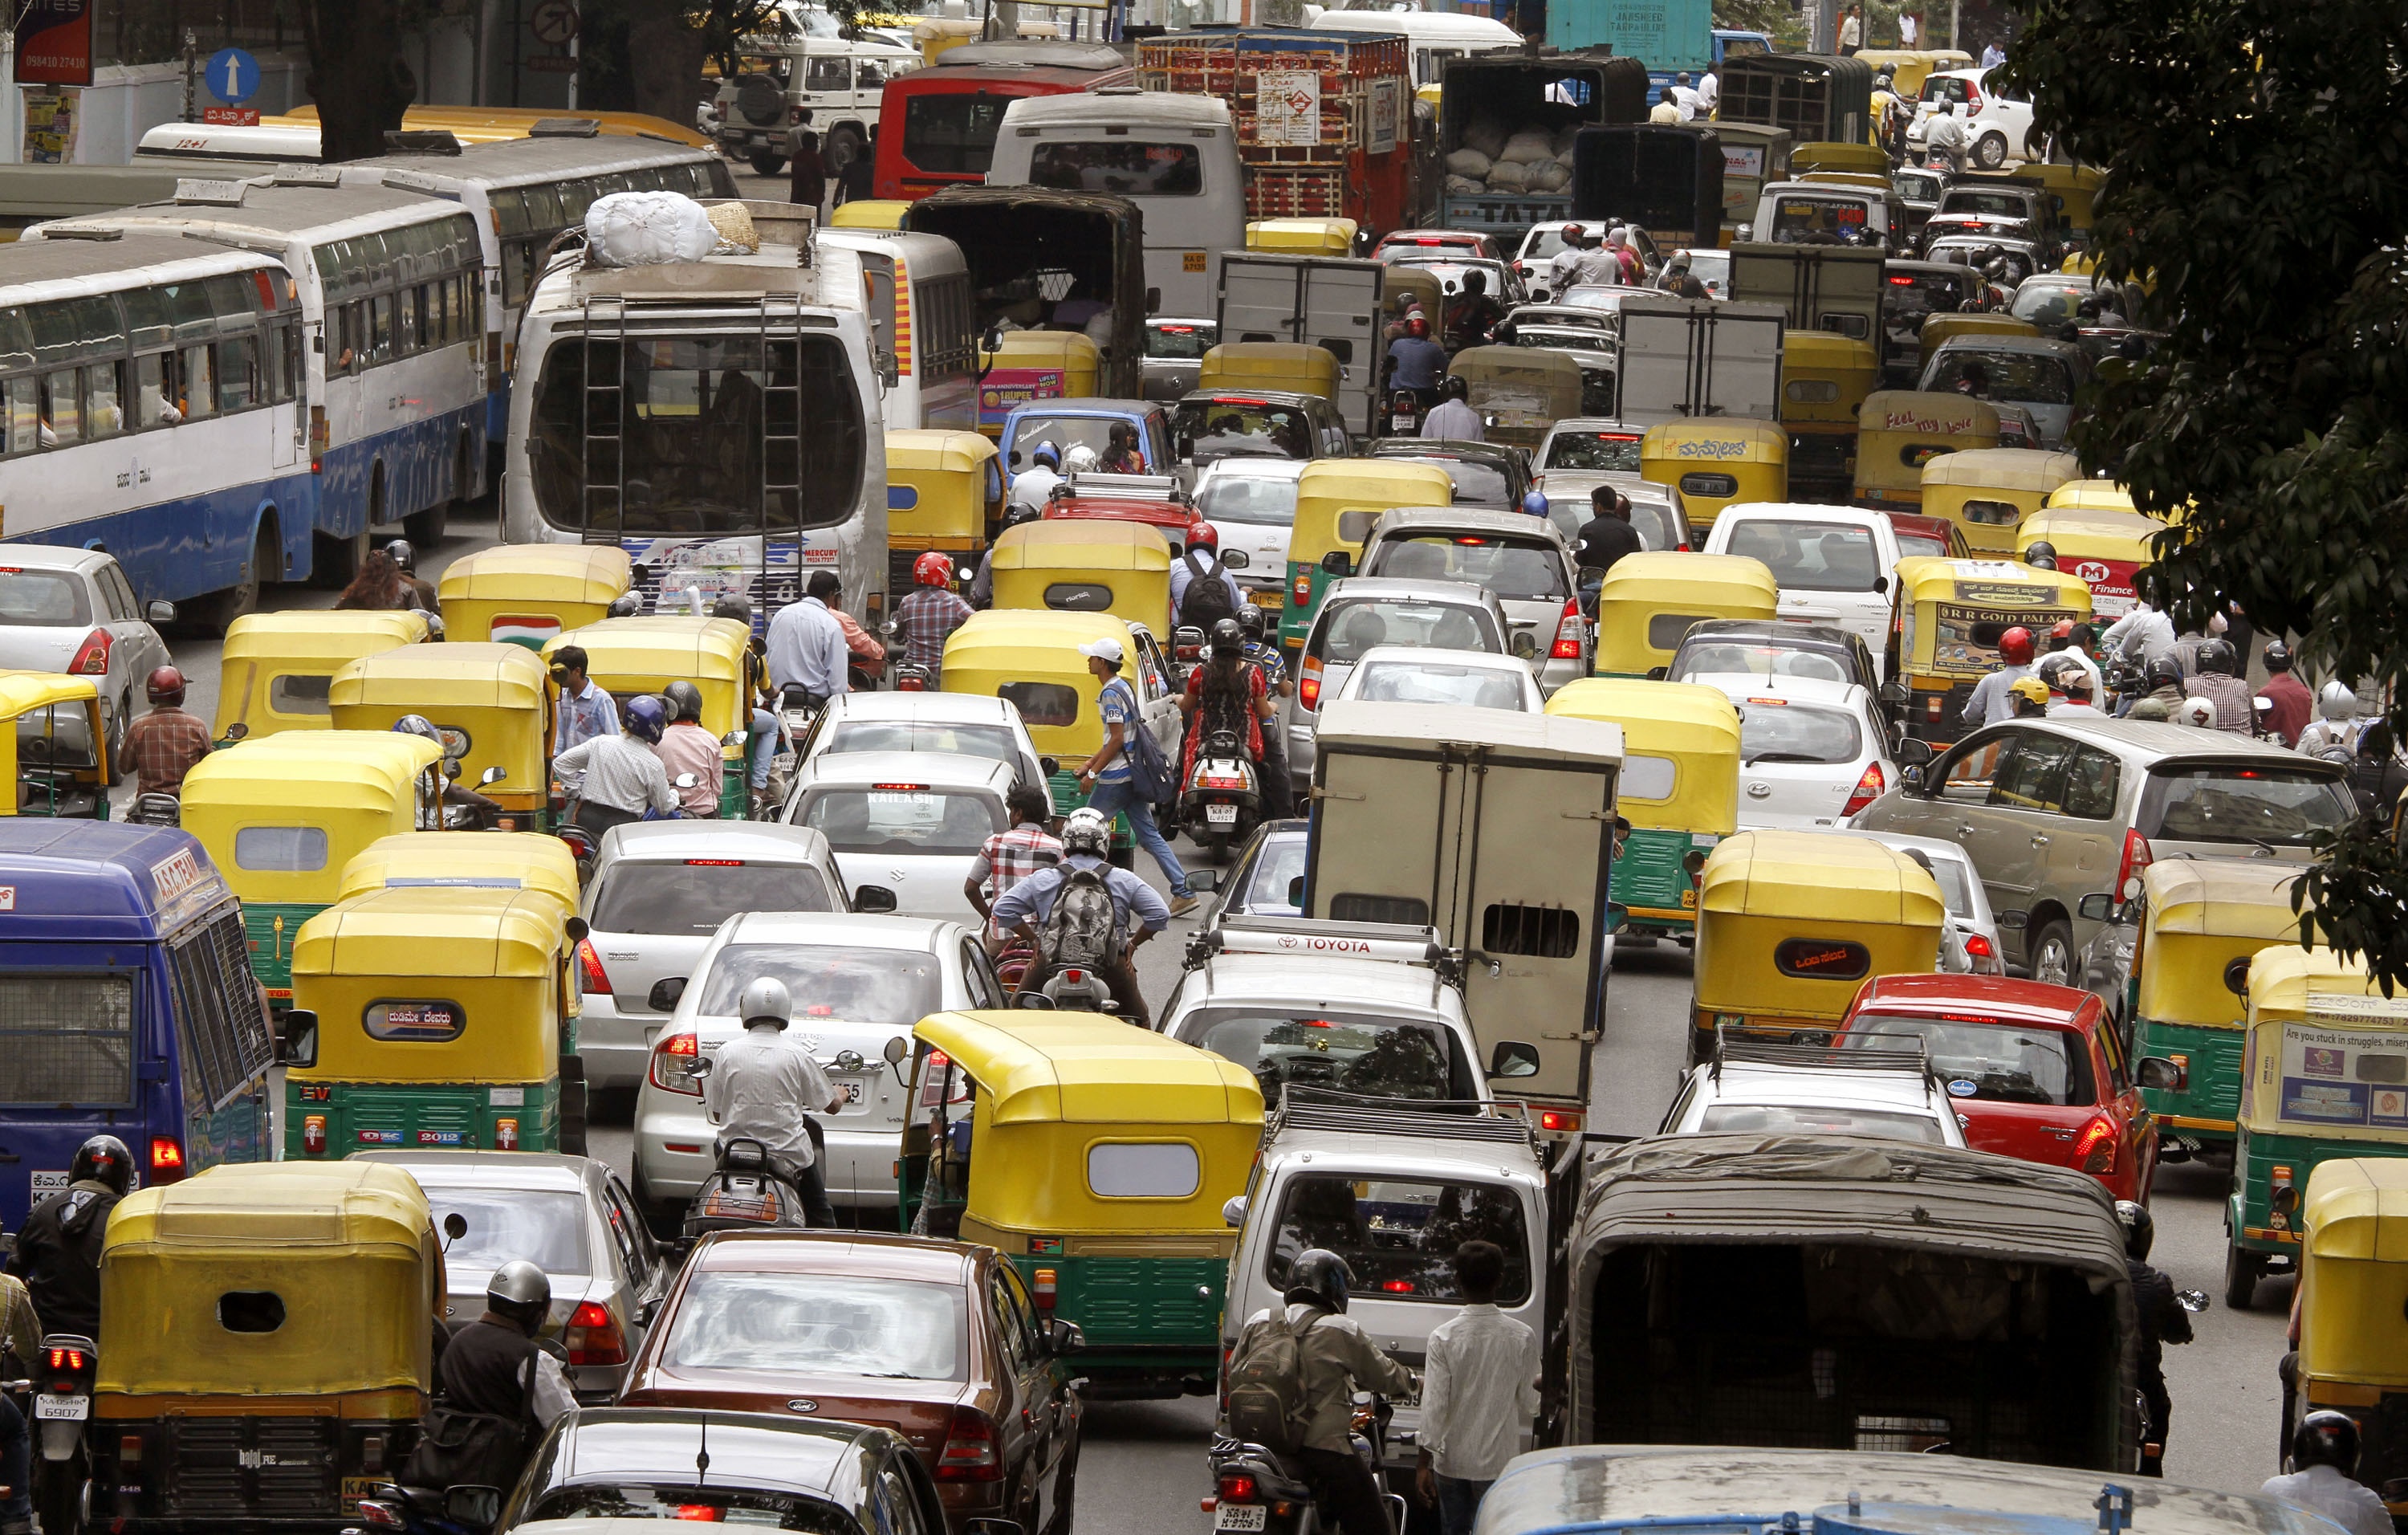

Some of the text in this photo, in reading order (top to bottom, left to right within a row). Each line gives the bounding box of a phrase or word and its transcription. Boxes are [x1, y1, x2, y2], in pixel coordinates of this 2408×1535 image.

[26, 55, 86, 69] 098410 27410
[175, 138, 209, 149] 12+1
[1478, 202, 1566, 223] TATA
[1039, 380, 1057, 388] NOW
[1886, 410, 1915, 430] Feel
[804, 549, 838, 557] MERCURY
[2095, 584, 2133, 595] Finance
[1951, 610, 1961, 618] R
[1967, 612, 1975, 620] R
[1980, 613, 2017, 622] GOLD
[1304, 938, 1370, 953] TOYOTA
[2315, 1012, 2329, 1020] Tel
[2286, 1028, 2299, 1039] Are
[2300, 1032, 2315, 1043] you
[2316, 1033, 2336, 1043] stuck
[2337, 1035, 2345, 1044] in
[2347, 1036, 2384, 1048] struggles,
[421, 1133, 458, 1141] 2012
[793, 1402, 811, 1410] Ford
[45, 1408, 79, 1418] 6907
[239, 1448, 261, 1469] bajaj
[262, 1455, 276, 1465] RE
